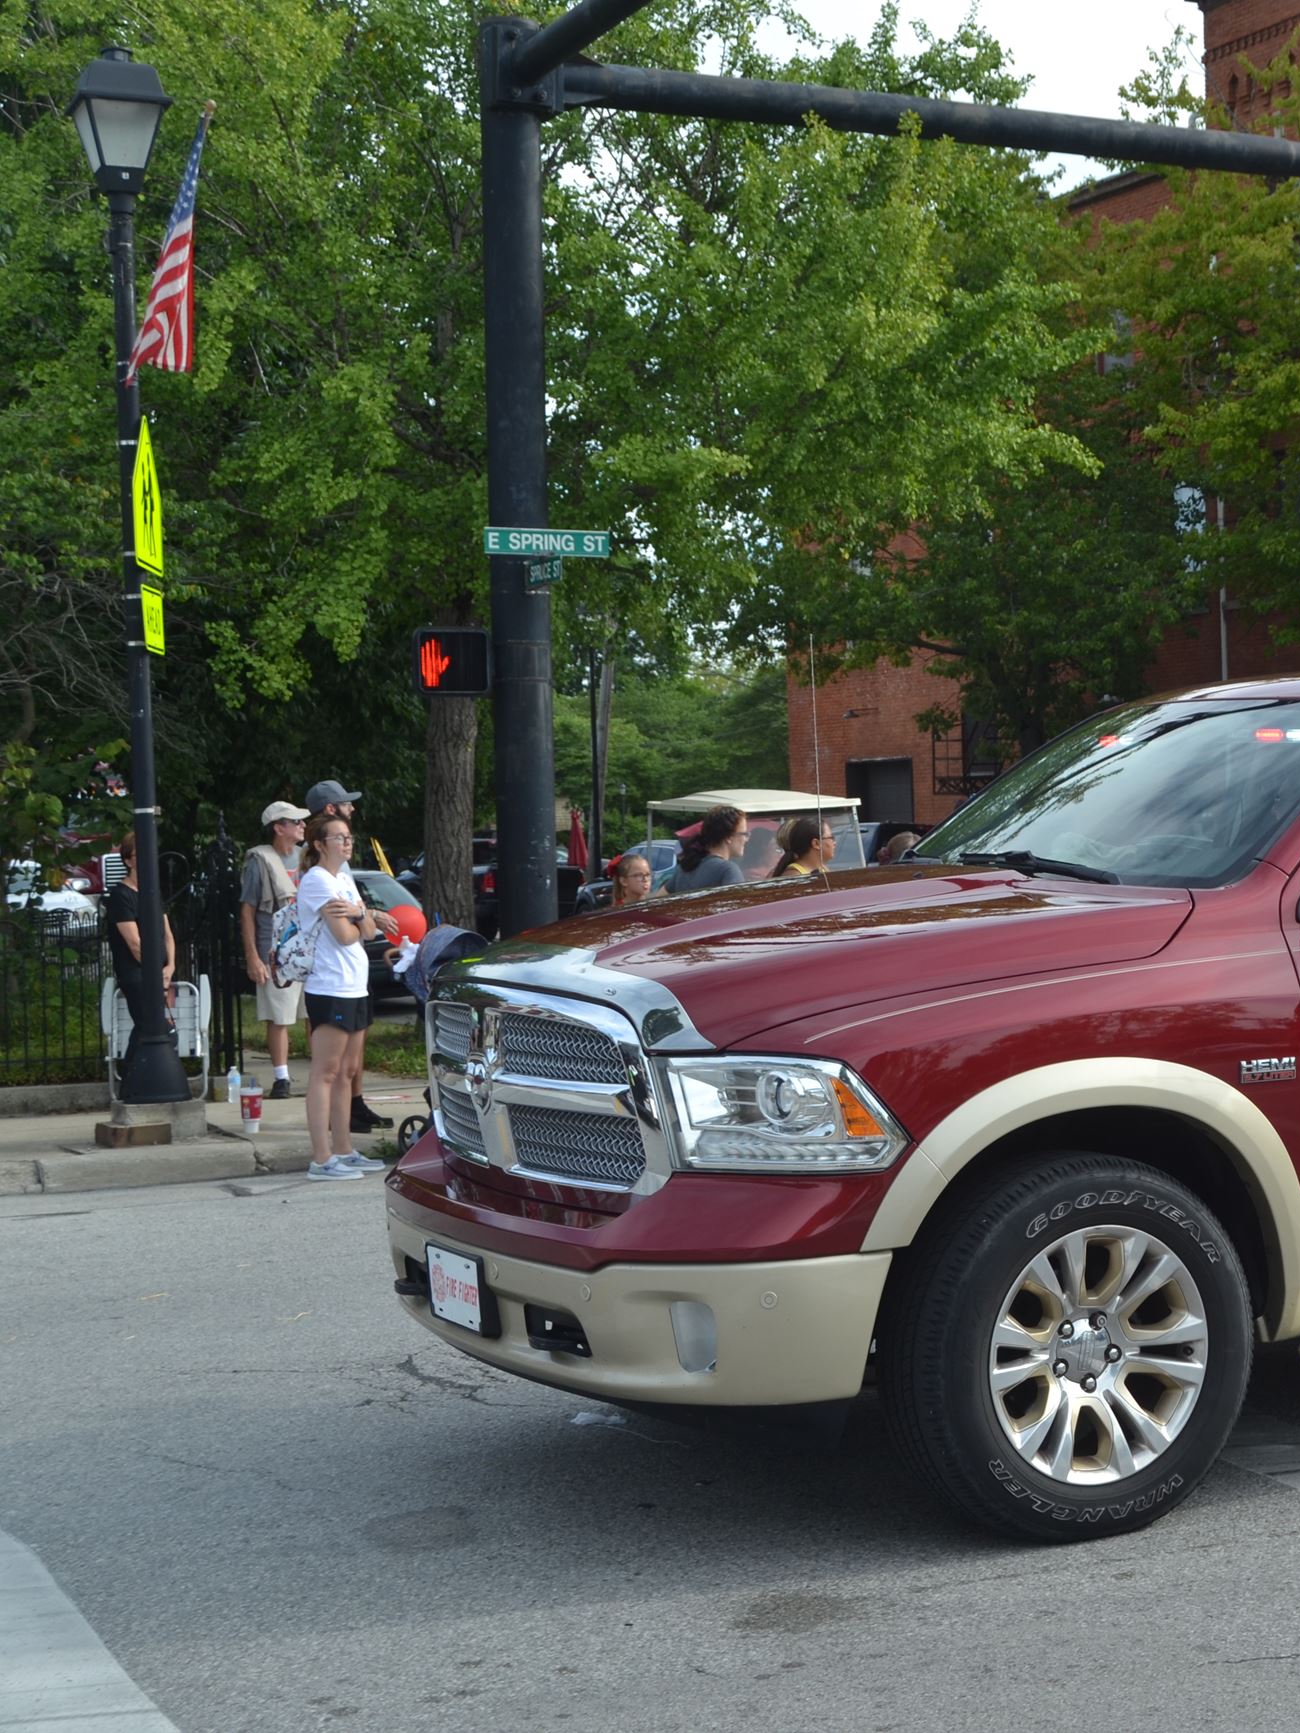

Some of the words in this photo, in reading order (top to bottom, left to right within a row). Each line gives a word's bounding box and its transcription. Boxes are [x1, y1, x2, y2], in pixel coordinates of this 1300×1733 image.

[488, 531, 500, 549] E
[508, 532, 575, 552] SPRING
[583, 534, 606, 552] ST
[1240, 1056, 1297, 1074] HEMI
[1026, 1189, 1222, 1264] GOODYEAR
[445, 1275, 457, 1298] FIRE
[988, 1458, 1184, 1523] WRANGLER
